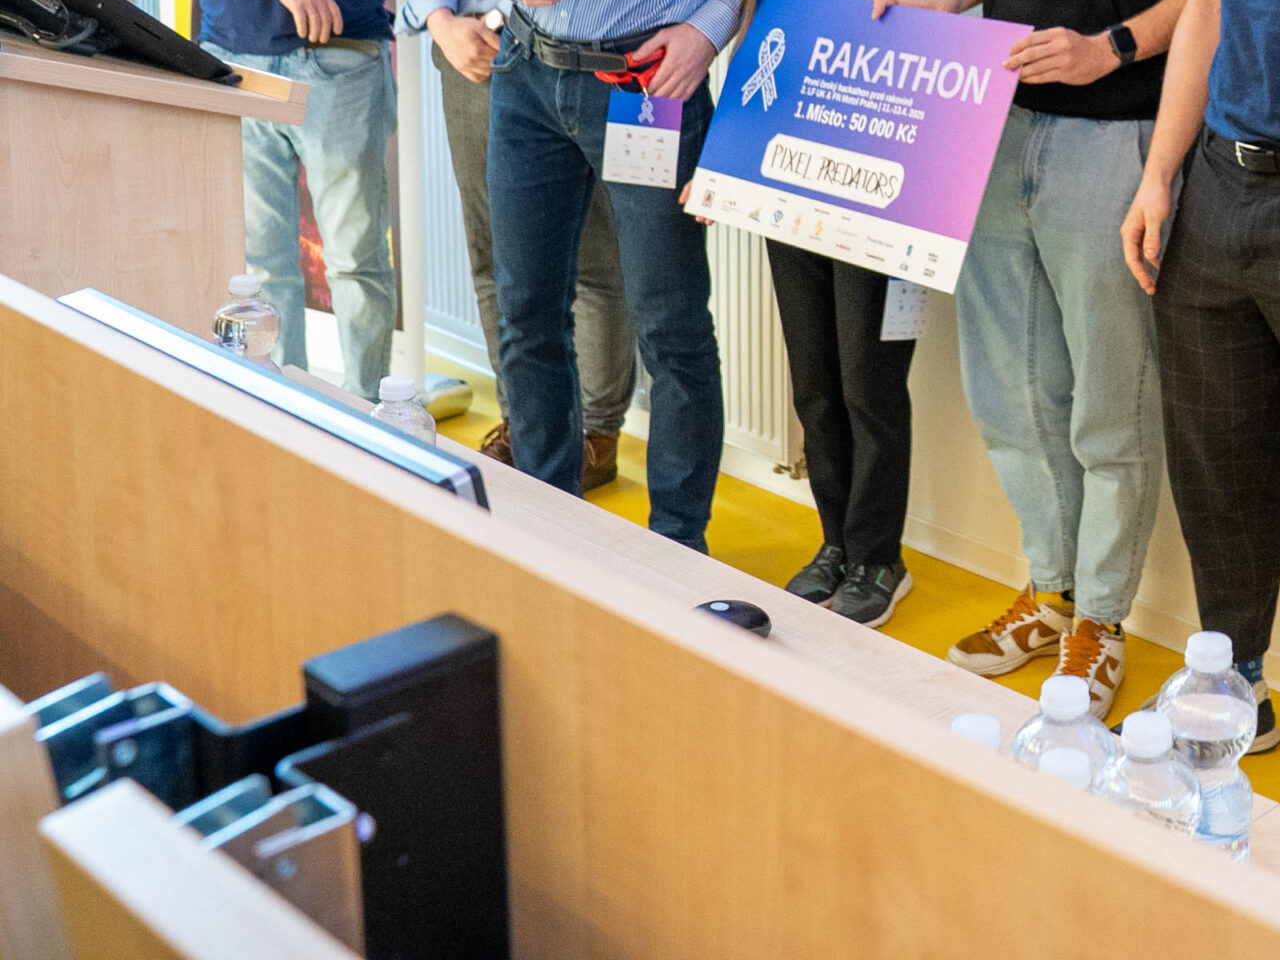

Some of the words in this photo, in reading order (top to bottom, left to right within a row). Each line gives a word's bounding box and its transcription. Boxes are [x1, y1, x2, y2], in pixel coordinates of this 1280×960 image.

[808, 36, 992, 106] RAKATHON
[793, 100, 805, 119] 1.
[805, 102, 848, 129] Místo:
[848, 112, 868, 134] 50
[868, 117, 896, 140] 000
[895, 123, 919, 145] Kč
[770, 144, 812, 181] PIXEL
[815, 155, 899, 201] PREDATORS
